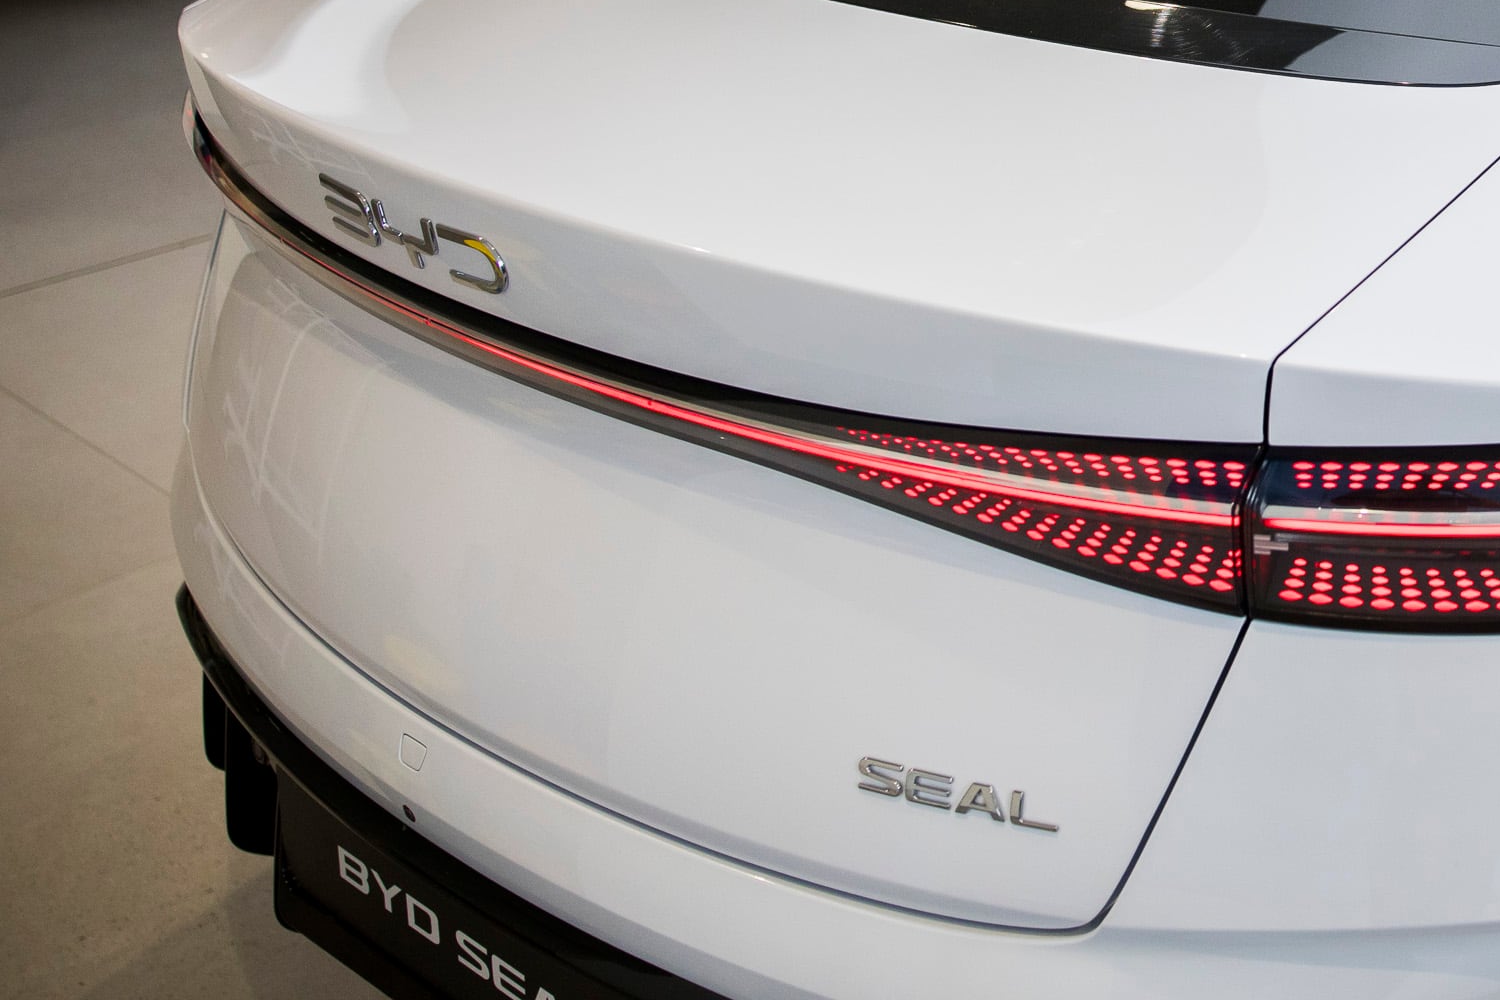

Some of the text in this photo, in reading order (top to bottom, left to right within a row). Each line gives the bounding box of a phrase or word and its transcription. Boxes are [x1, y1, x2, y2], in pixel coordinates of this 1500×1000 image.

[318, 172, 510, 294] BYD
[857, 756, 1060, 832] SEAL
[337, 844, 441, 945] BYD
